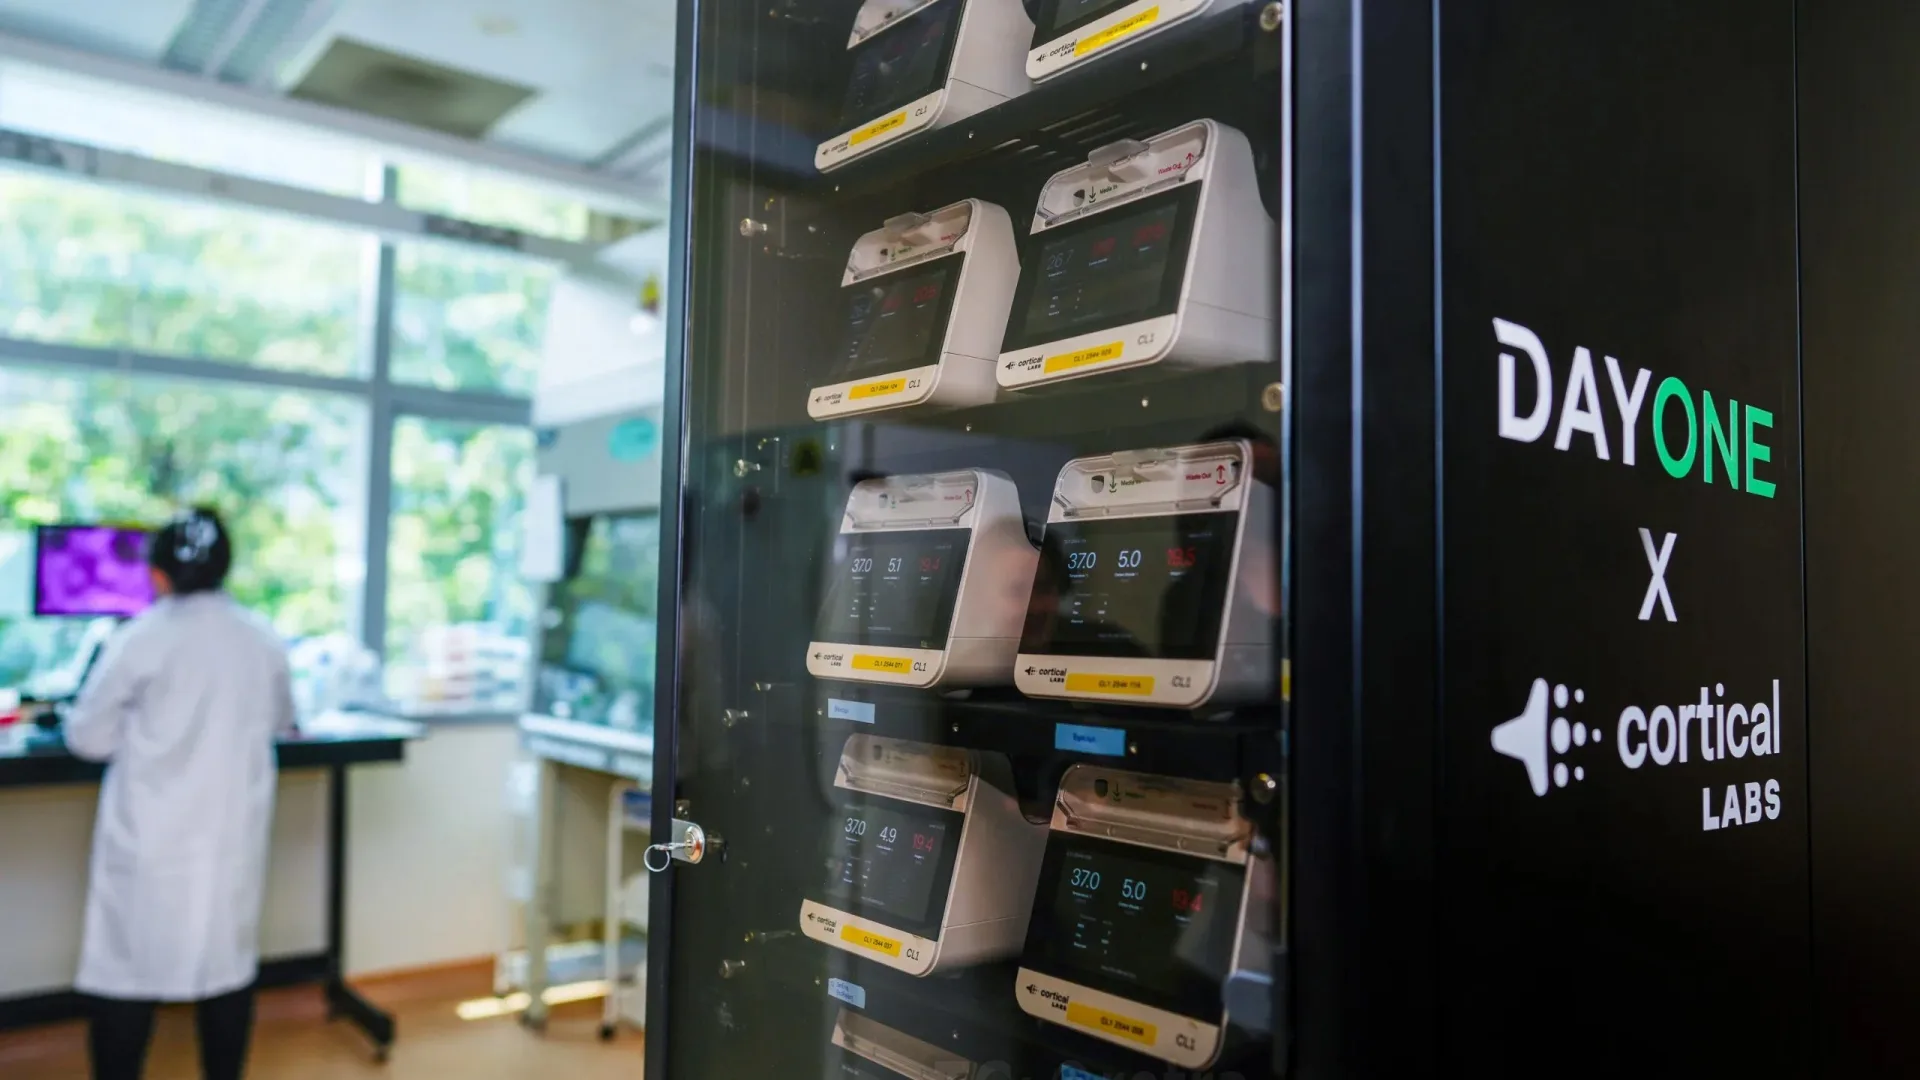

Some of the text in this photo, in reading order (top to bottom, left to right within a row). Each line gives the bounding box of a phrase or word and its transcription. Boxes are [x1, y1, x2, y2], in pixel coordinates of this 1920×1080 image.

[1050, 38, 1078, 57] cortical
[1018, 354, 1044, 368] cortical
[823, 391, 843, 402] cortical
[1492, 317, 1777, 499] DAYONE
[851, 557, 873, 573] 37.0
[887, 557, 903, 573] 5.1
[1067, 551, 1097, 570] 37.0
[1117, 549, 1142, 569] 5.0
[1637, 527, 1678, 623] X
[823, 652, 844, 663] cortical
[913, 661, 927, 672] CL1
[1039, 667, 1067, 677] cortical
[1616, 678, 1781, 770] cortical
[1701, 777, 1781, 831] LABS
[844, 817, 867, 836] 37.0
[879, 826, 898, 844] 4.9
[1070, 867, 1101, 891] 37.0
[1121, 877, 1147, 901] 5.0
[817, 915, 837, 928] cortical
[906, 948, 920, 962] CL1
[1040, 988, 1070, 1004] cortical
[1052, 1001, 1067, 1012] LABS
[1175, 1032, 1197, 1052] CL1
